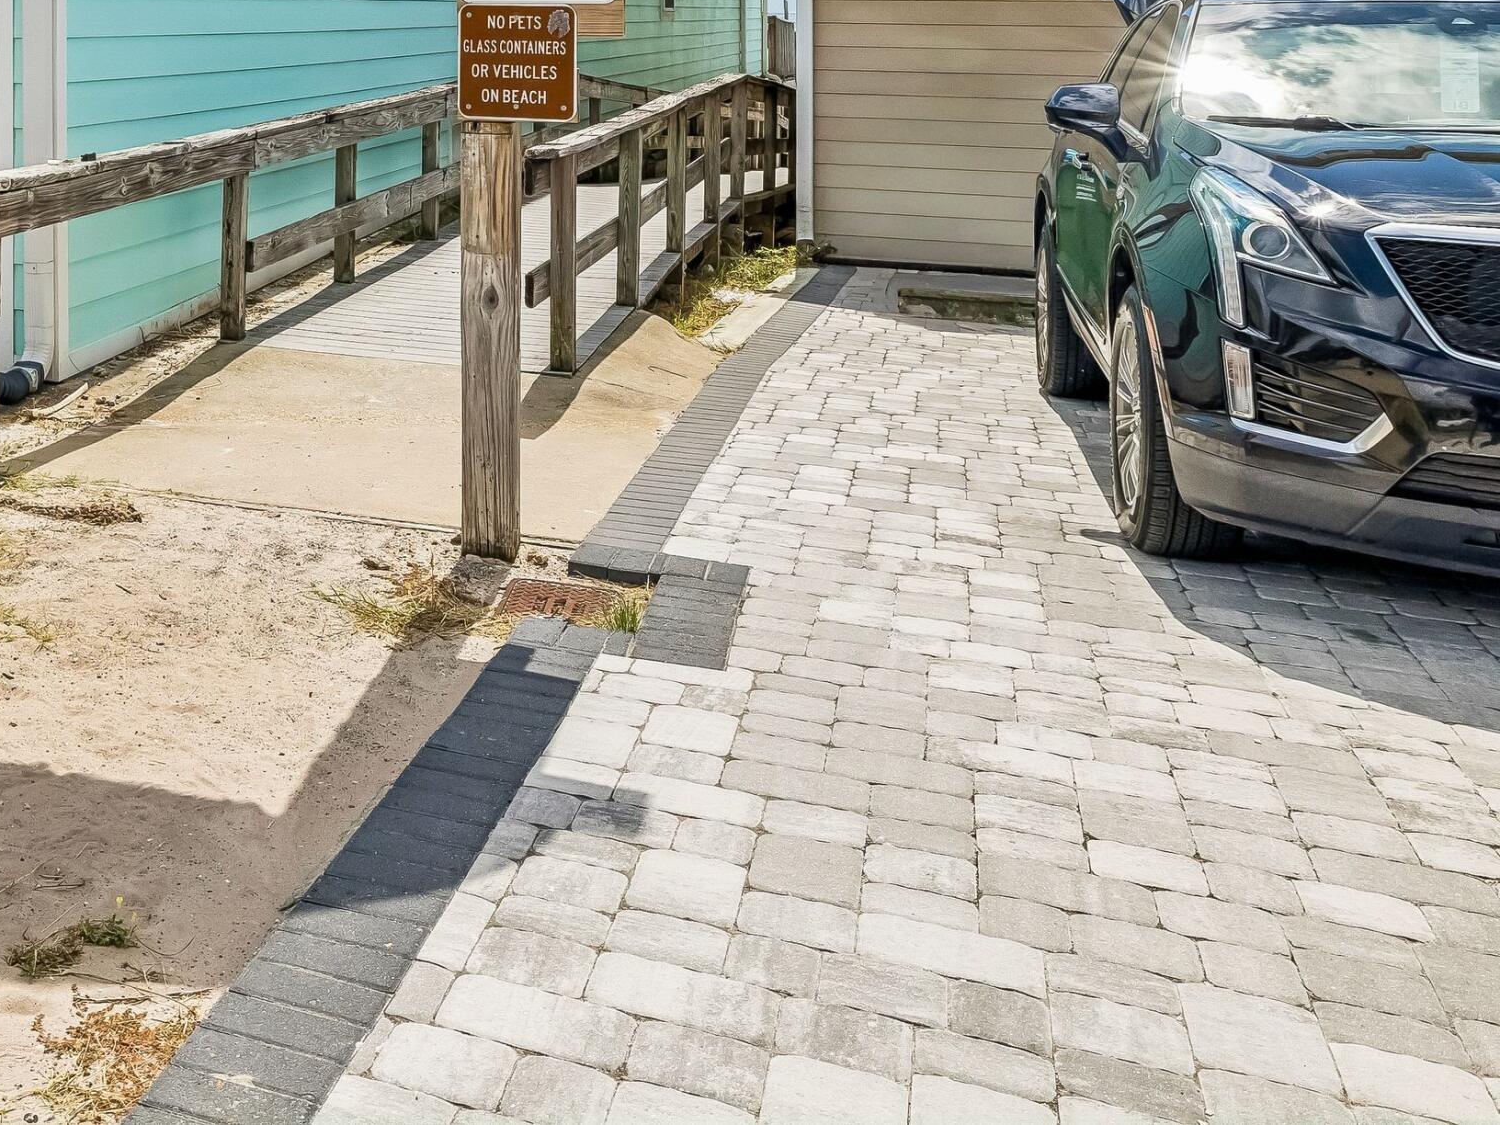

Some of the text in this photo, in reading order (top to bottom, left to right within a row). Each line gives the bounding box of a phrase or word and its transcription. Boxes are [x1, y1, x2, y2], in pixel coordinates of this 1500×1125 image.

[487, 15, 542, 29] NO PETS
[463, 40, 567, 55] GLASS CONTAINERS
[471, 64, 557, 79] OR VEHICLES
[481, 88, 547, 104] ON BEACH
